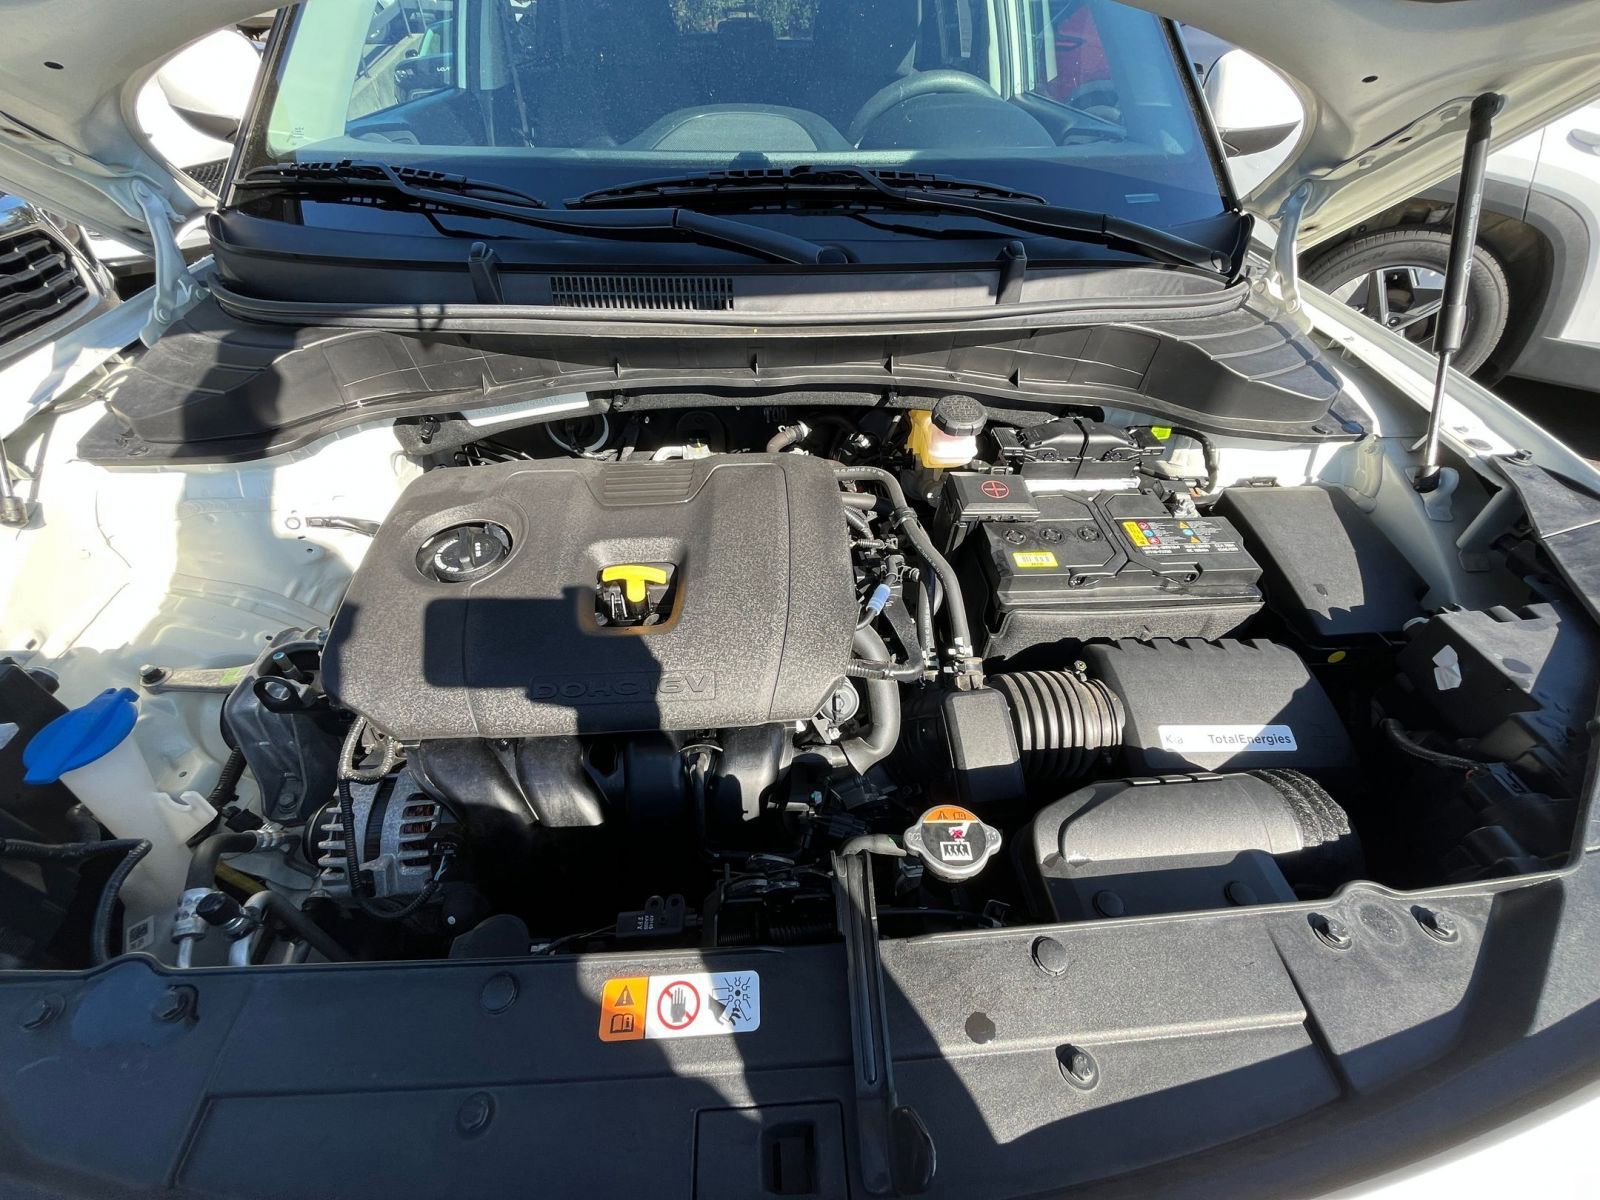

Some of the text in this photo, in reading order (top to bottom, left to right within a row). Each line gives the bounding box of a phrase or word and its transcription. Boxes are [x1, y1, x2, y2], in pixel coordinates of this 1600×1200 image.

[533, 674, 708, 699] DOHC 16V
[1207, 733, 1292, 746] TotalEnergies
